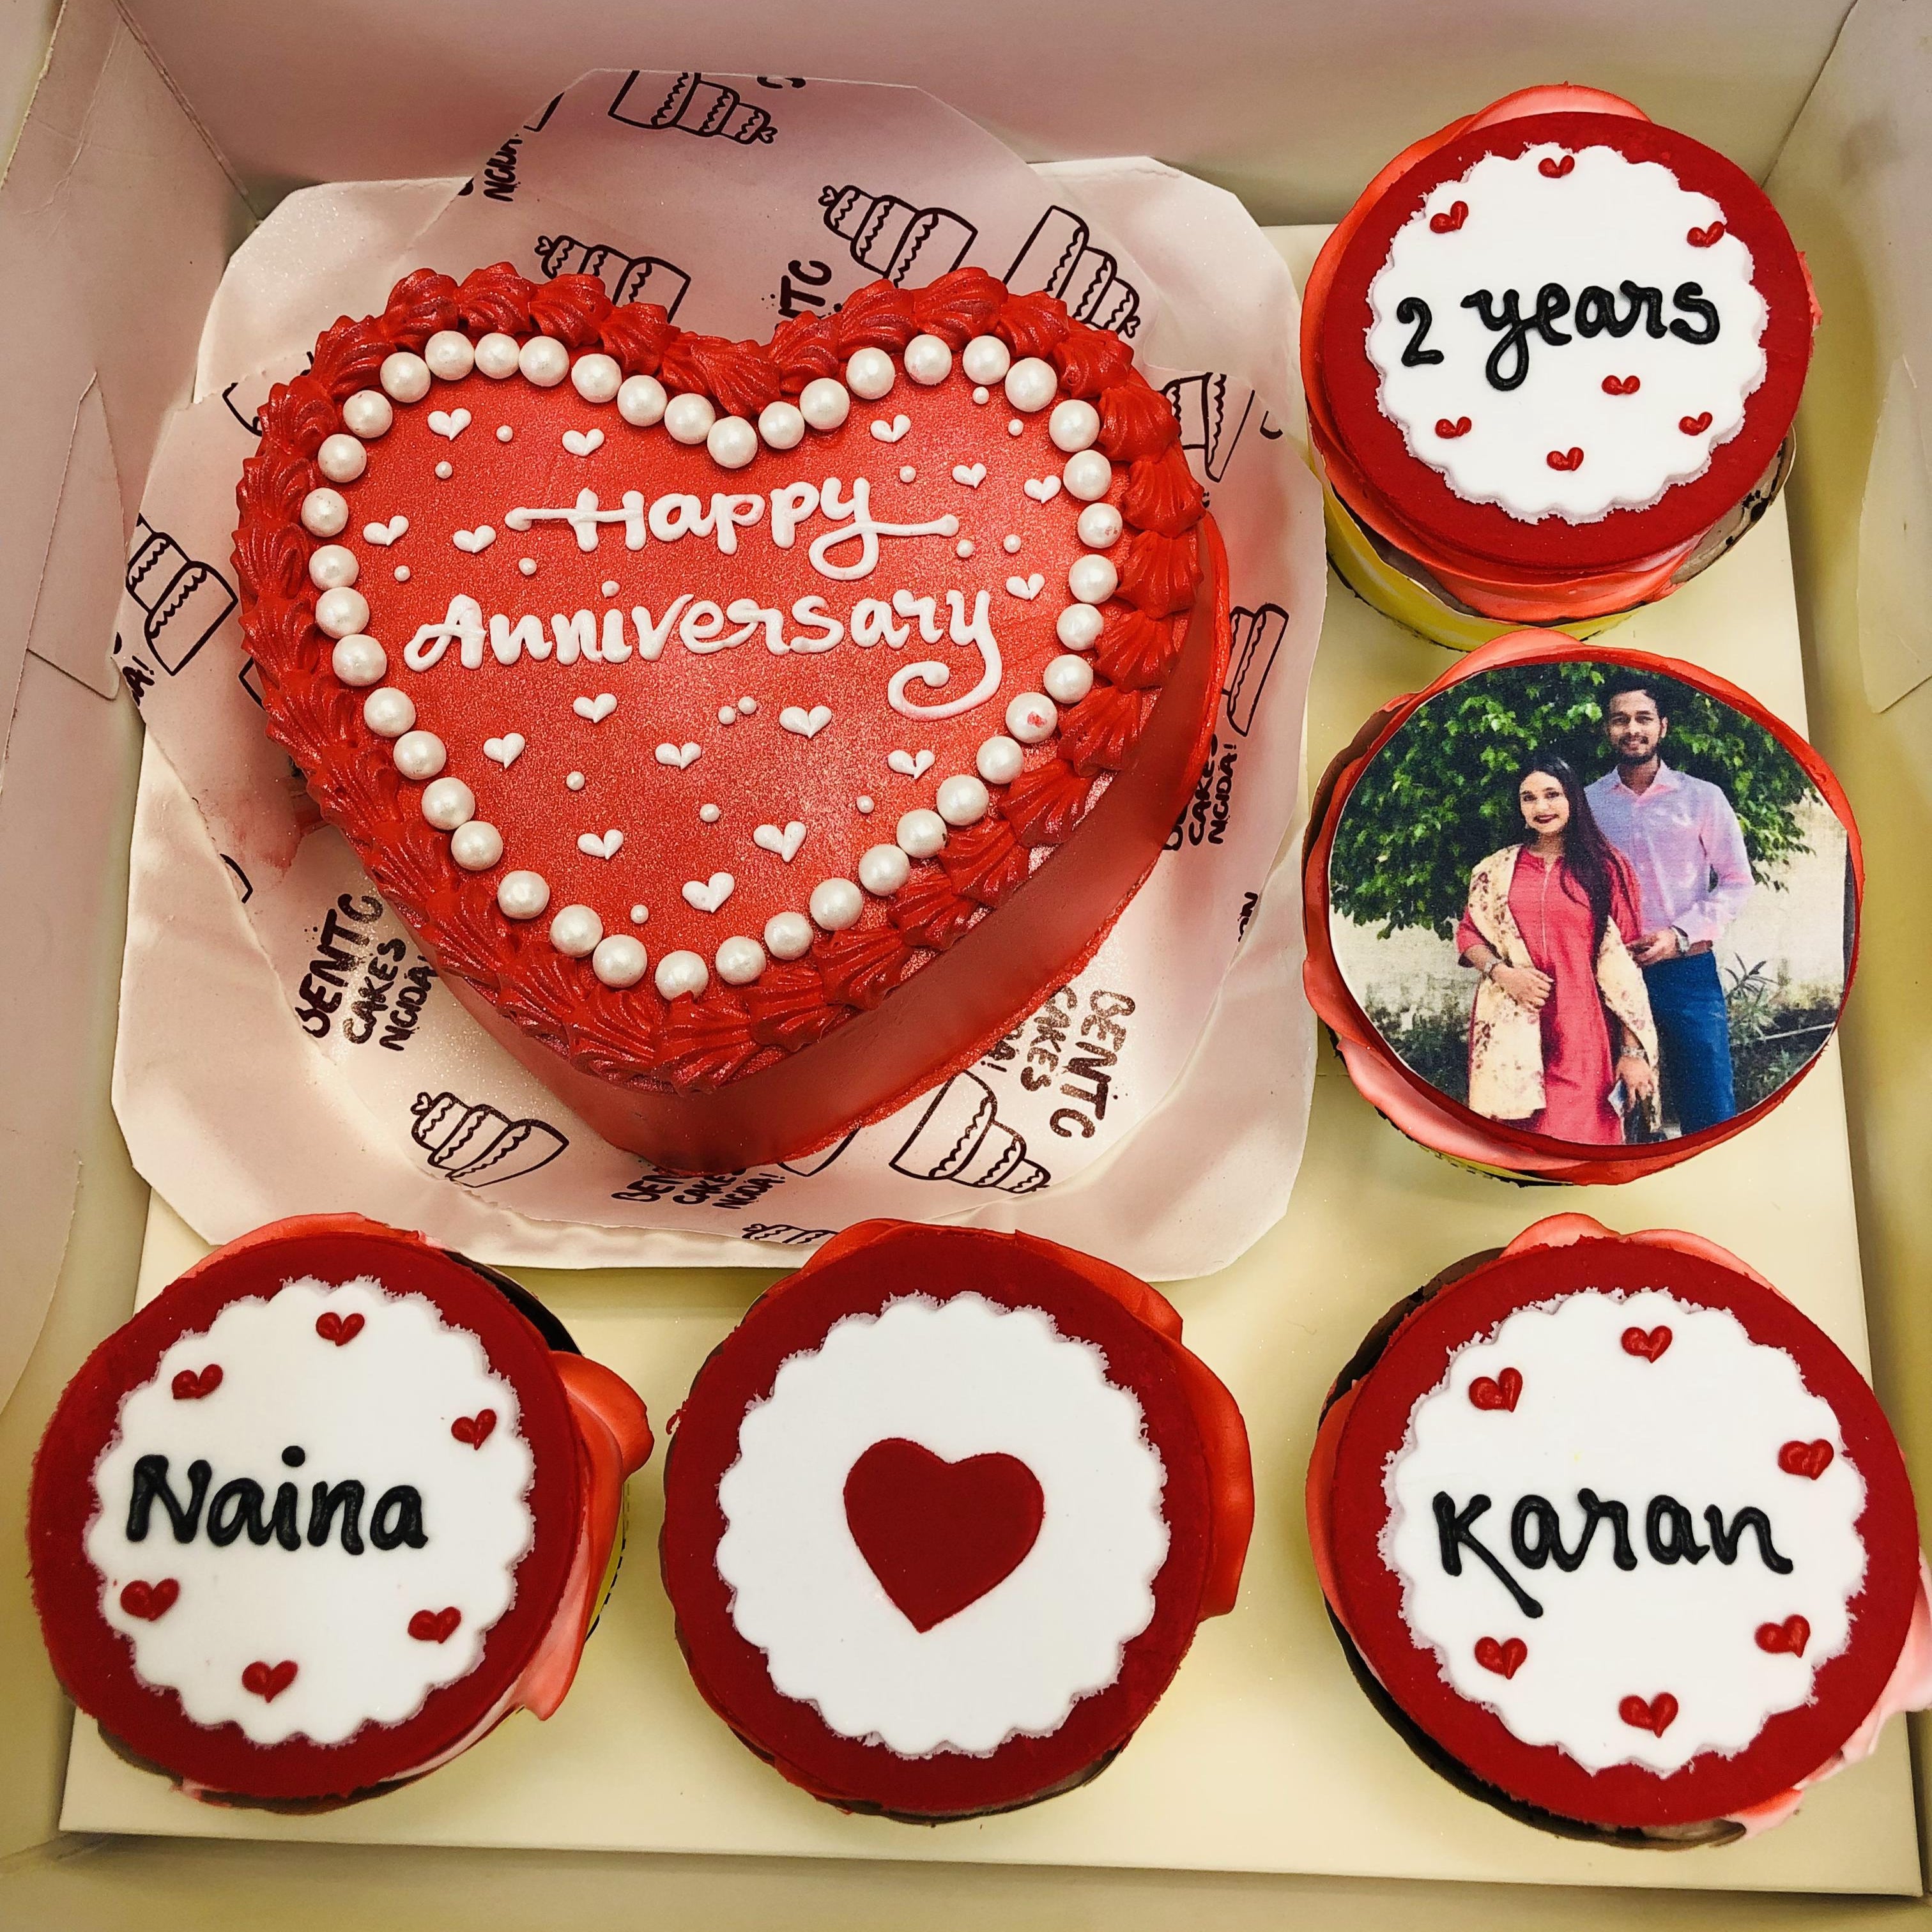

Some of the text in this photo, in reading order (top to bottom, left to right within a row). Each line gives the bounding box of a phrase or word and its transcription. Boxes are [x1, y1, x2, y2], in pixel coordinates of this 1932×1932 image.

[1396, 280, 1721, 392] 2 years
[505, 477, 960, 581] Happy
[404, 579, 1003, 719] Anniversary
[342, 938, 406, 1045] CAKES
[673, 1168, 746, 1205] CAKE
[125, 1445, 429, 1556] Naina
[1432, 1488, 1794, 1619] Karan
